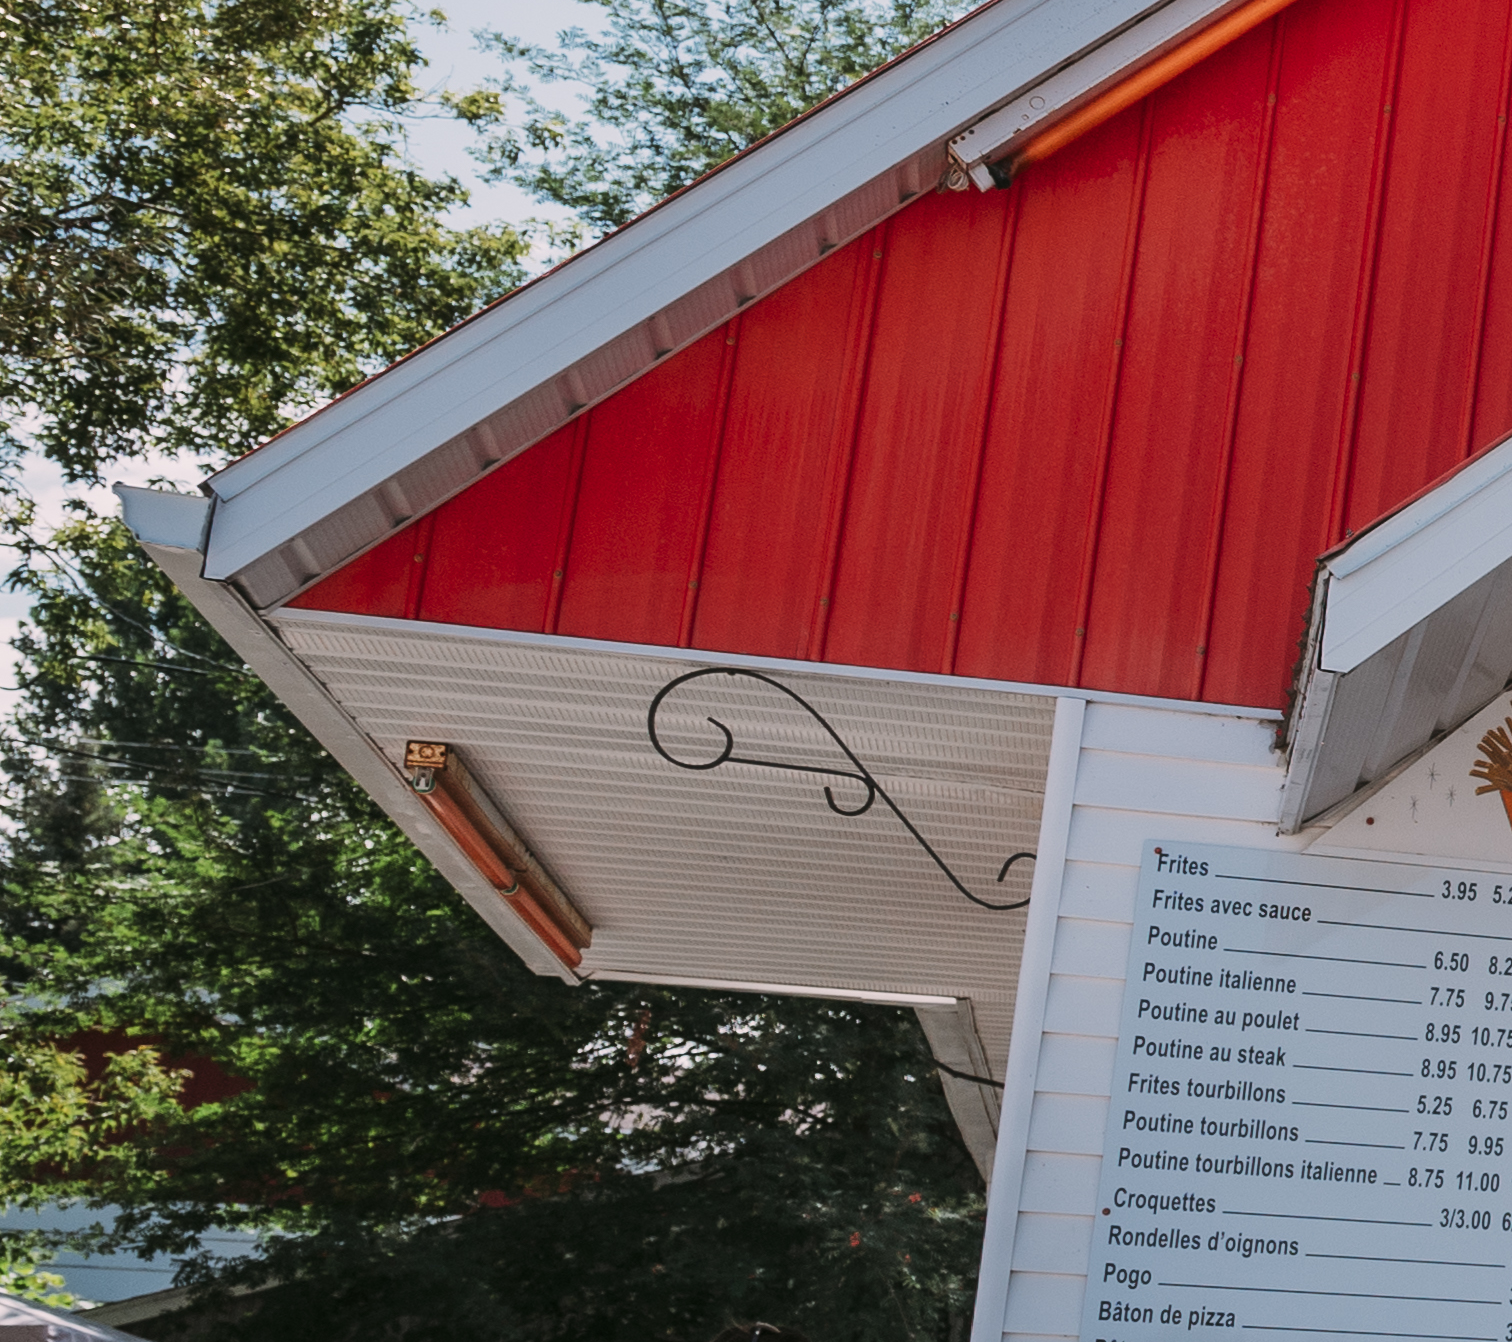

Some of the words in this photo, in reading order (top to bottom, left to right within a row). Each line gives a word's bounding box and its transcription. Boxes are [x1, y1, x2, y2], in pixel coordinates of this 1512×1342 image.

[1157, 852, 1208, 876] Frites
[1442, 880, 1477, 901] 3.95
[1153, 889, 1204, 912] Frites
[1211, 899, 1252, 916] avec
[1259, 904, 1311, 922] sauce
[1148, 926, 1217, 950] Poutine
[1434, 951, 1469, 972] 6.50
[1128, 1073, 1180, 1095] Frites
[1187, 1079, 1285, 1103] tourbillons
[1417, 1095, 1452, 1116] 5.25
[1473, 1099, 1508, 1120] 6.75
[1118, 1147, 1189, 1171] Poutine
[1196, 1154, 1294, 1178] tourbillons
[1301, 1160, 1377, 1184] italienne
[1408, 1168, 1444, 1188] 8.75
[1457, 1171, 1499, 1192] 11.00
[1114, 1188, 1215, 1214] Croquettes
[1440, 1208, 1491, 1230] 3/3.00
[1108, 1225, 1201, 1250] Rondelles
[1104, 1263, 1151, 1289] Pogo
